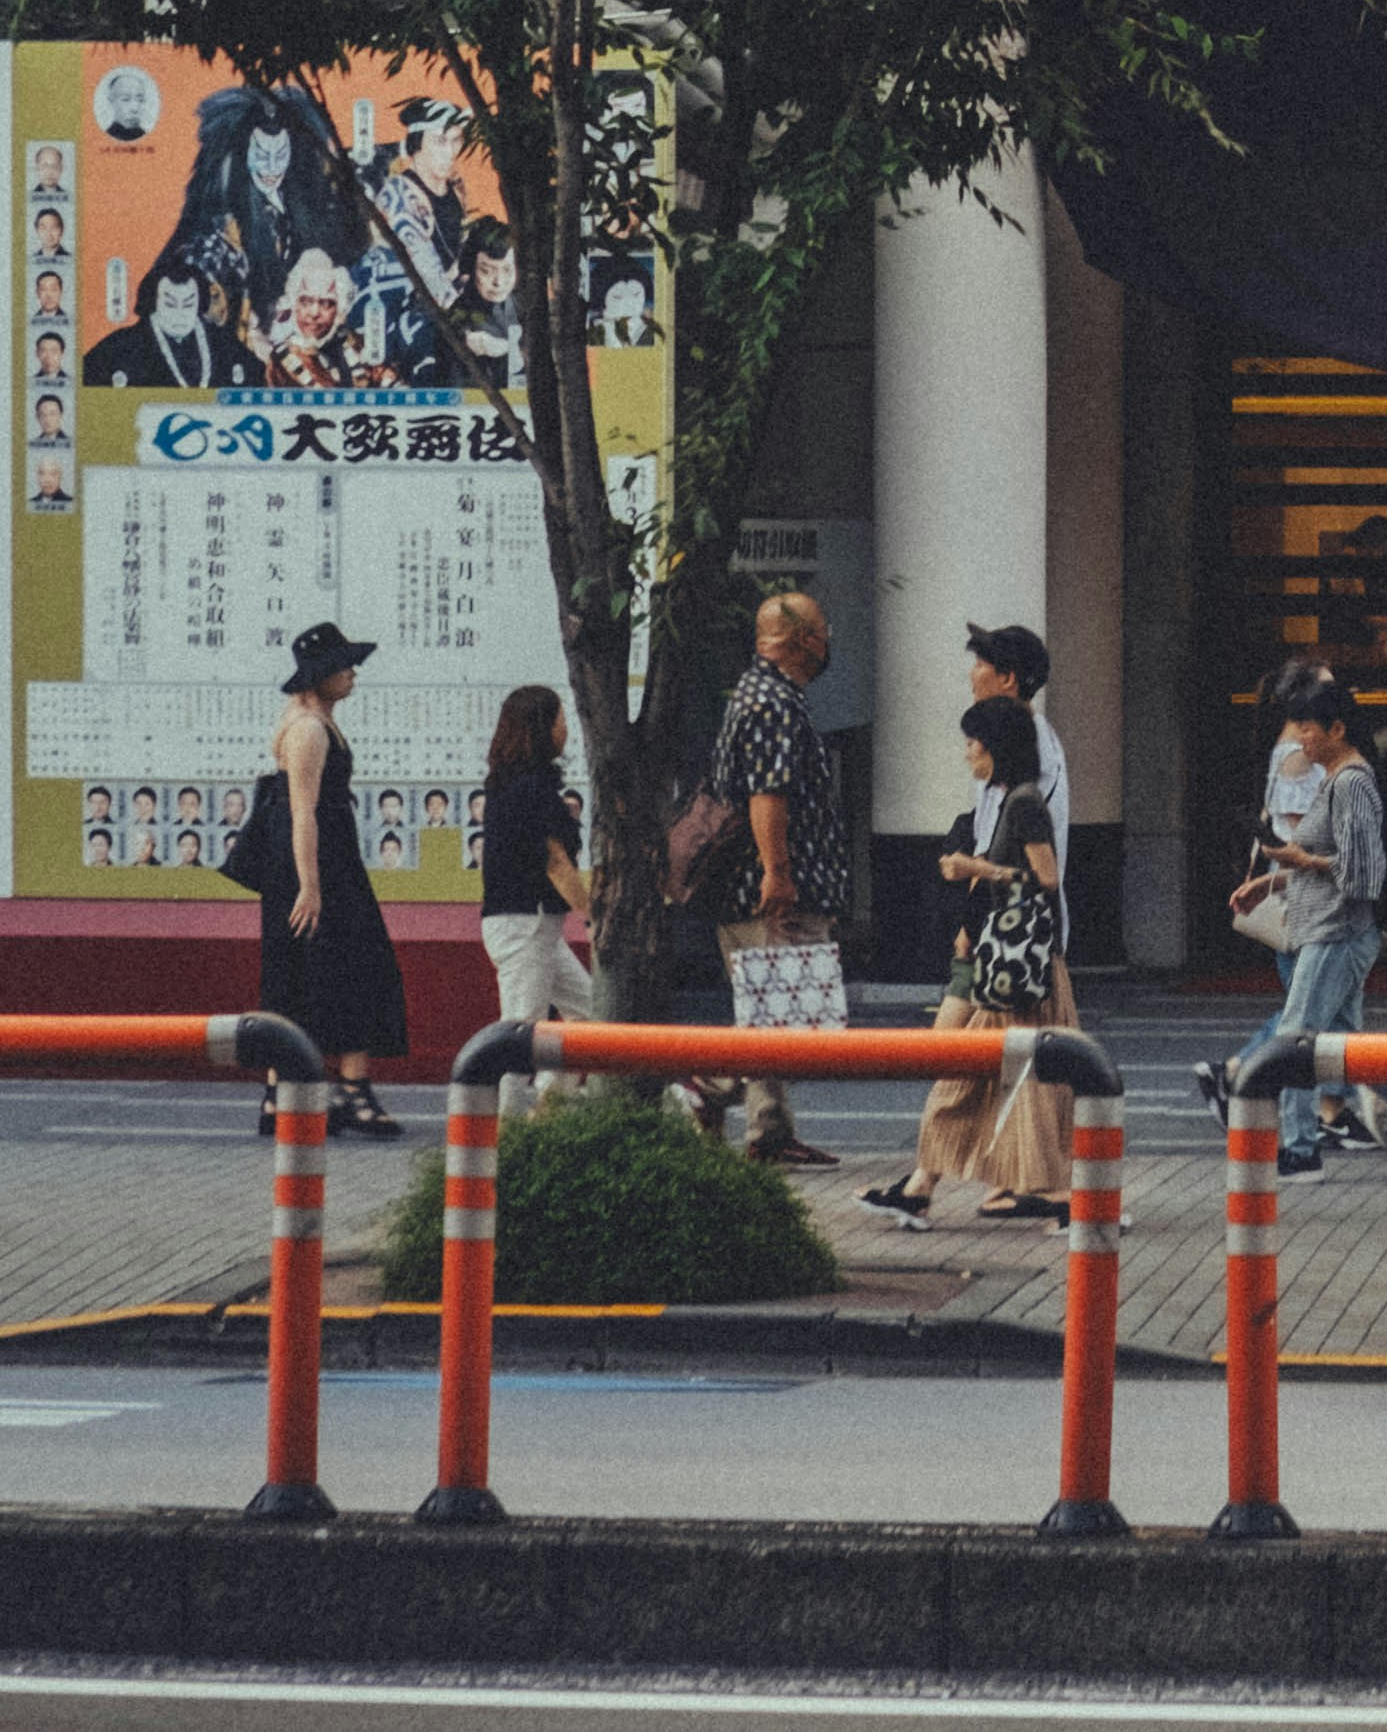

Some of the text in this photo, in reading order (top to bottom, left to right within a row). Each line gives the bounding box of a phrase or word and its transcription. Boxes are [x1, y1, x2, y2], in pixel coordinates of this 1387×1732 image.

[455, 493, 475, 648] 菊宴月白浪
